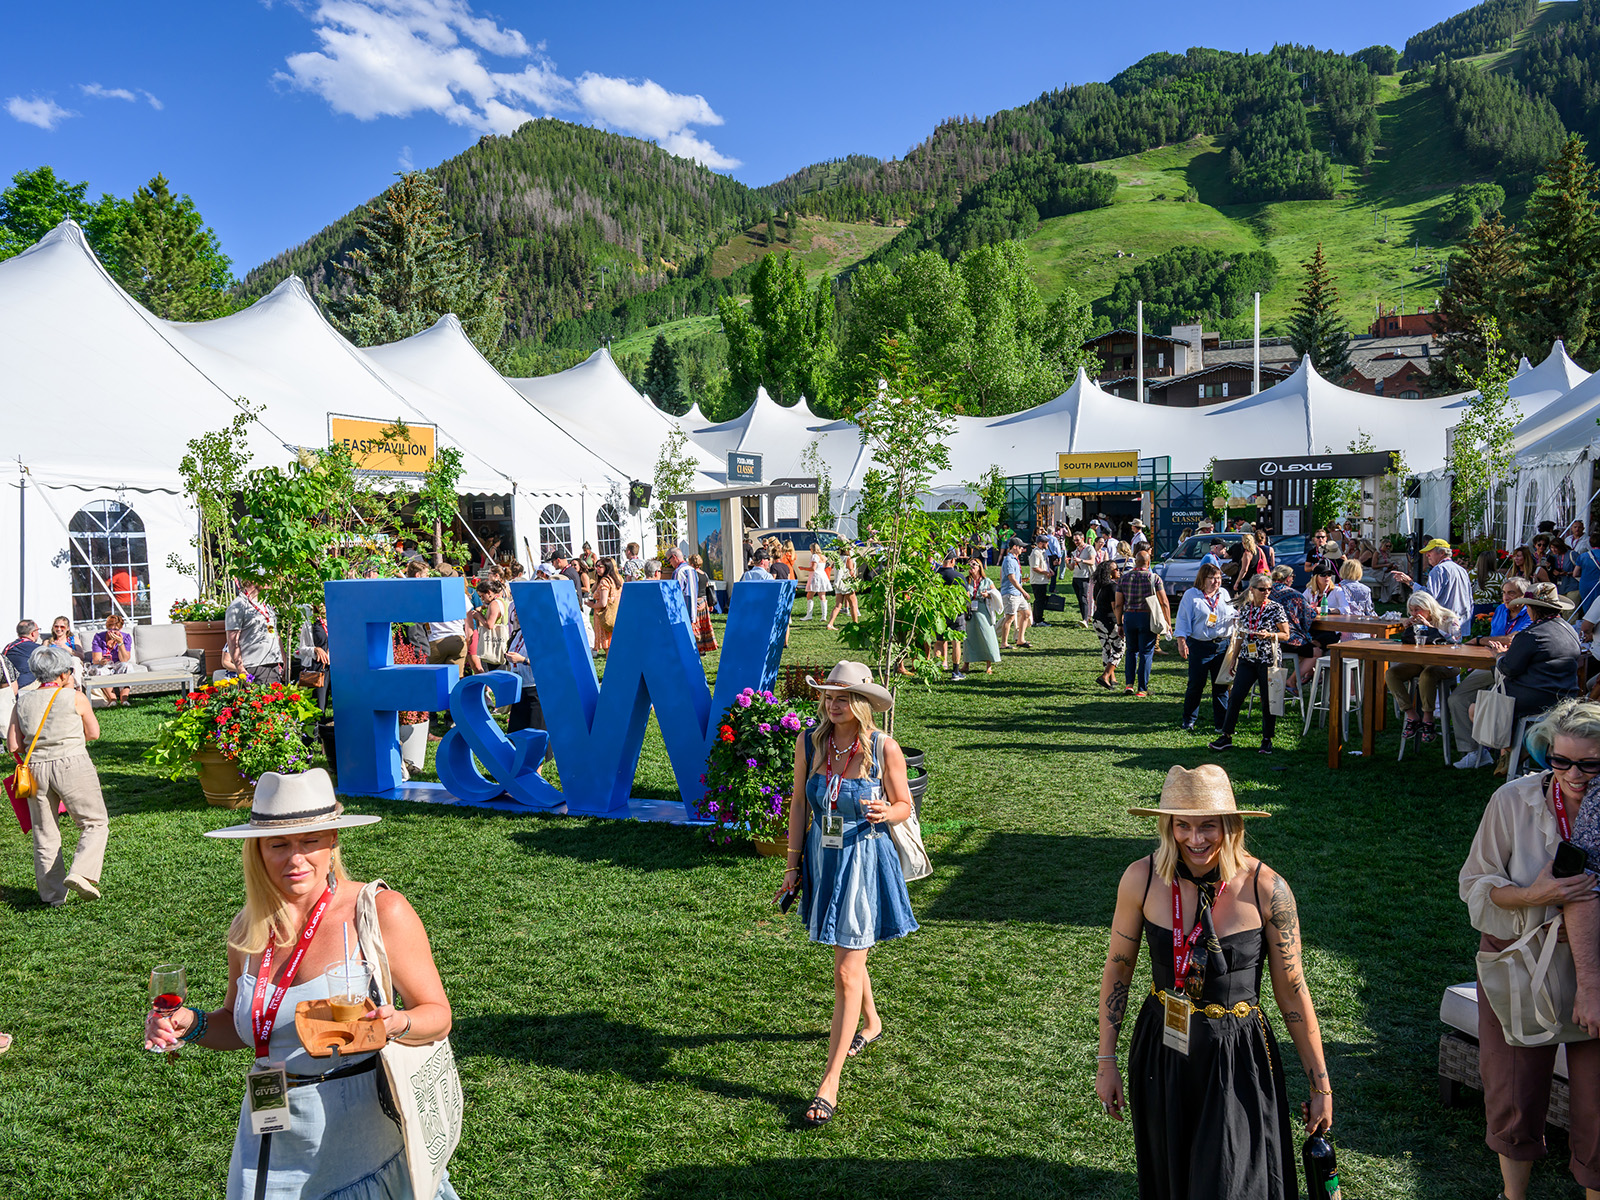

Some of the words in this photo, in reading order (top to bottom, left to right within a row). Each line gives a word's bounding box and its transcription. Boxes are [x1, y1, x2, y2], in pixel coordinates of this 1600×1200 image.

[343, 438, 373, 453] EAST
[378, 441, 427, 456] PAVILION
[1063, 462, 1092, 470] SOUTH
[1094, 461, 1133, 469] PAVILION
[1279, 462, 1334, 473] LEXUS
[263, 947, 273, 968] 2025
[260, 1019, 273, 1041] 2025
[254, 1086, 281, 1097] GIVES
